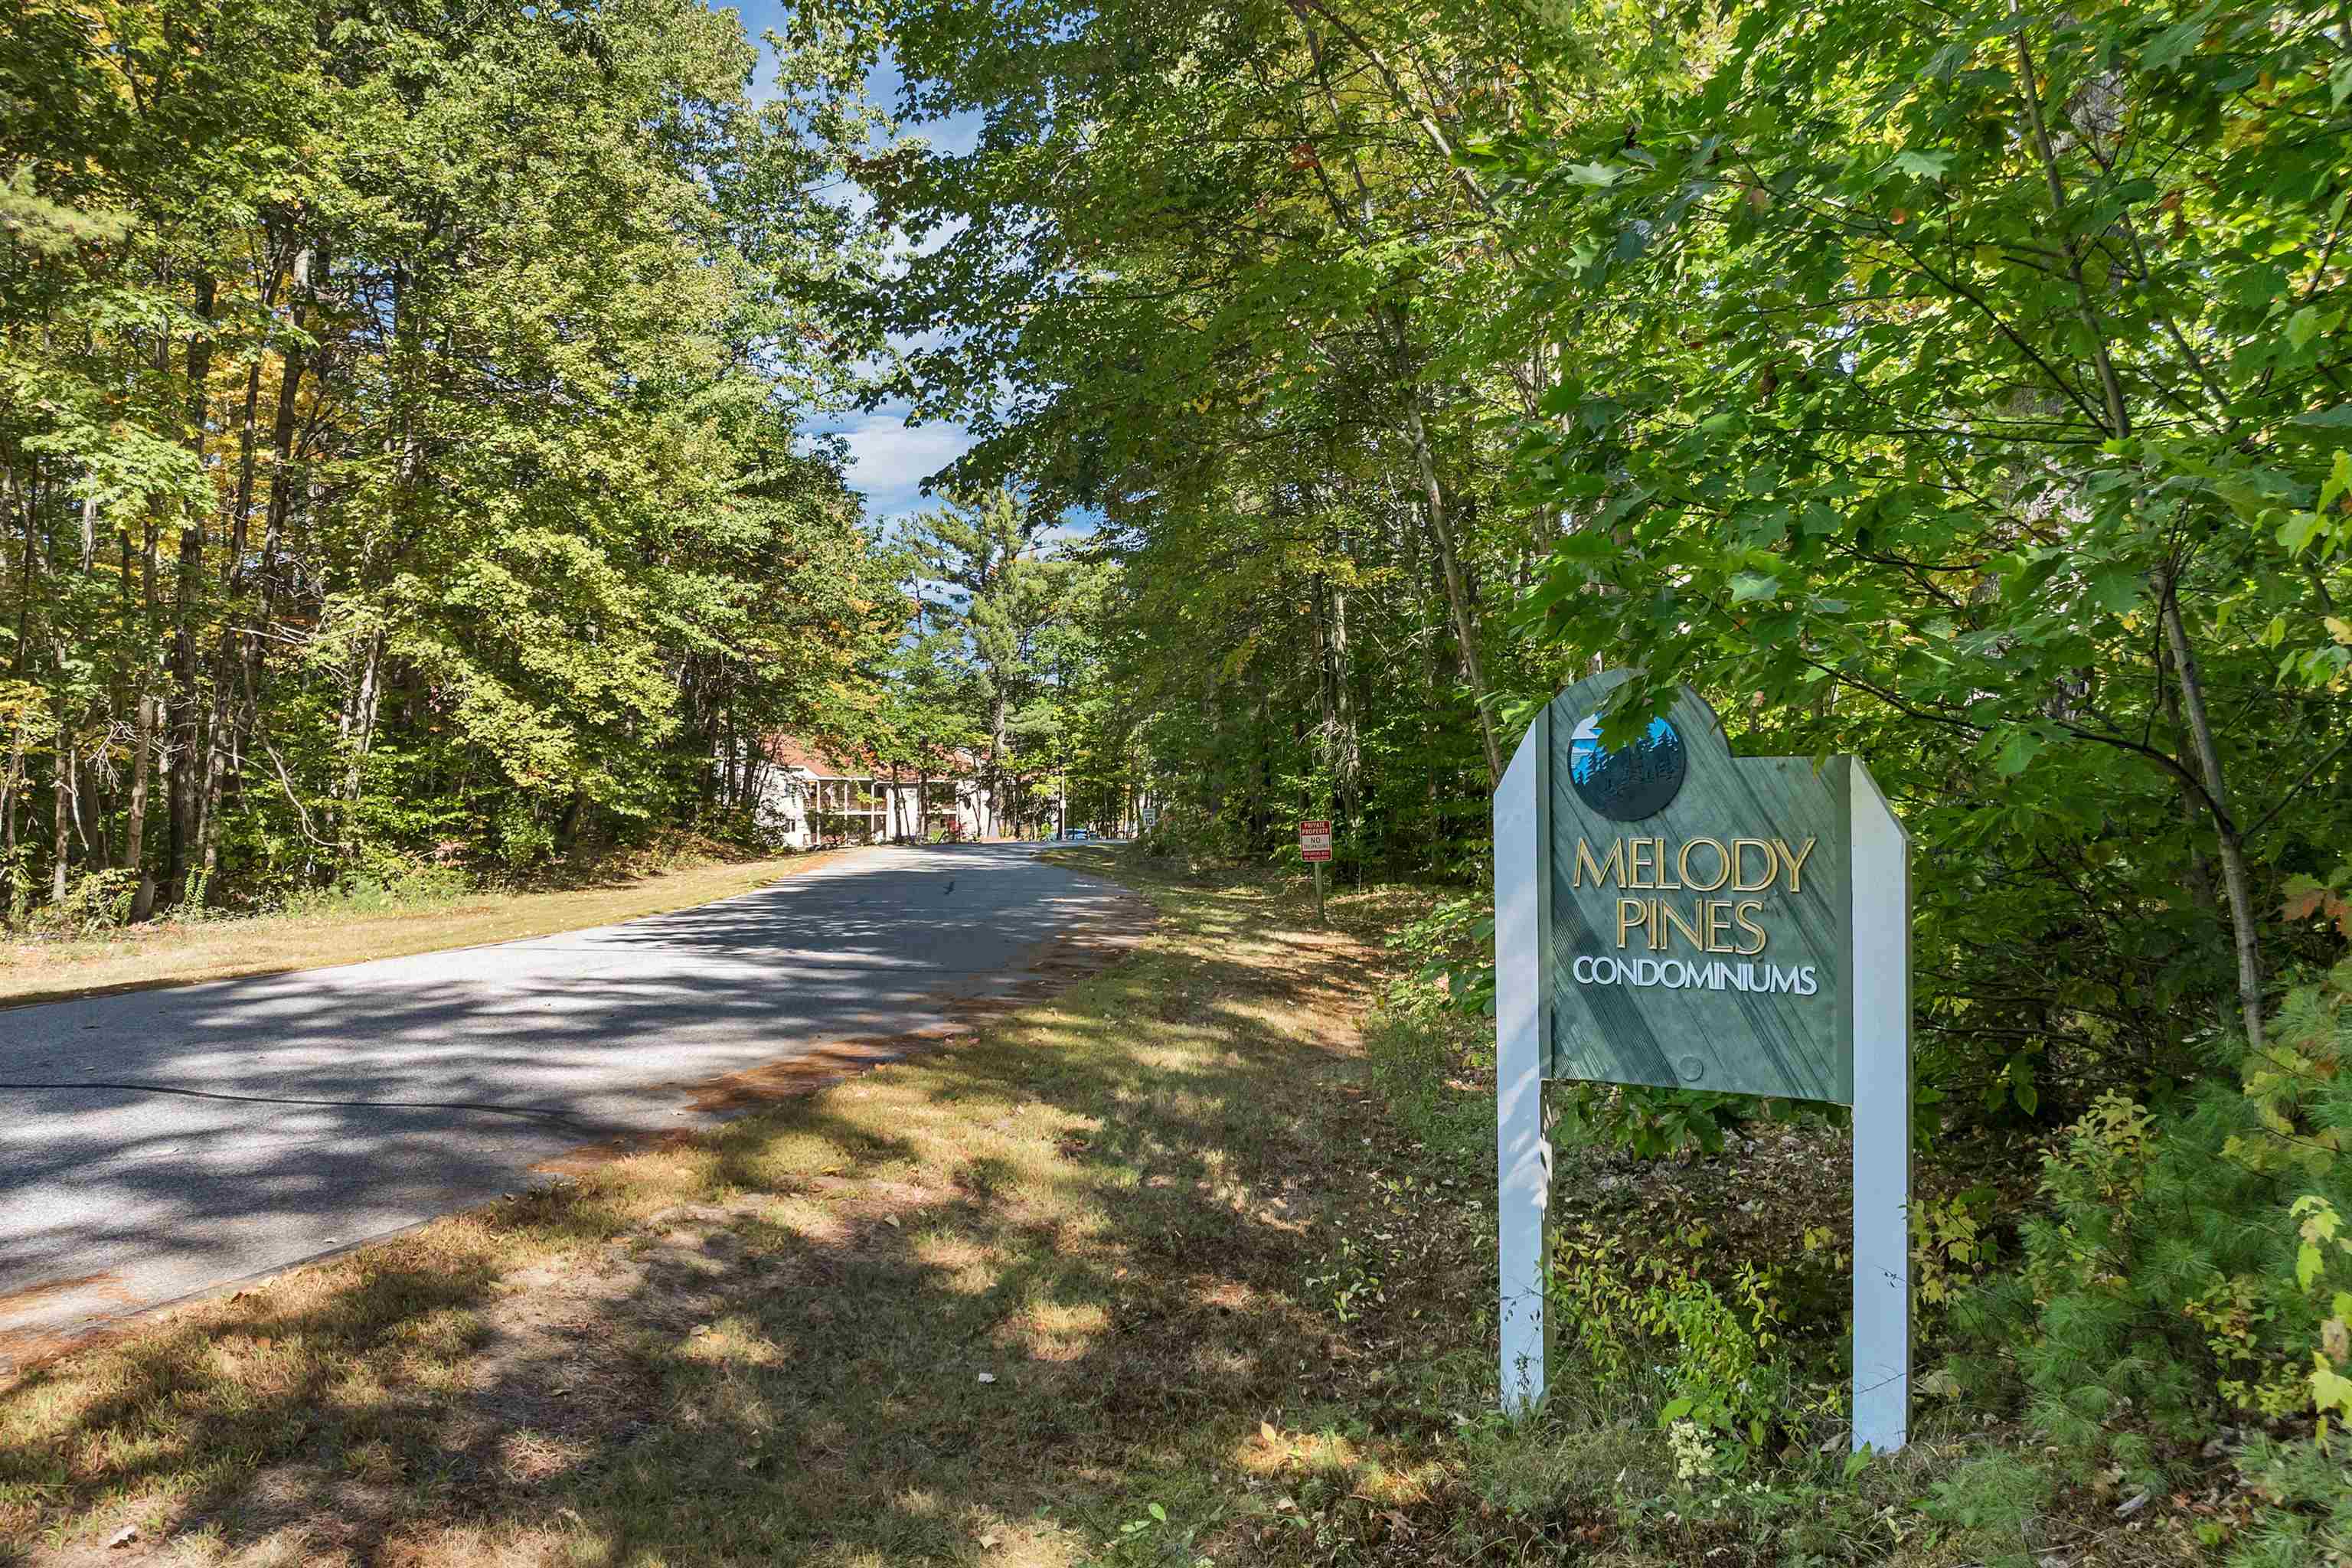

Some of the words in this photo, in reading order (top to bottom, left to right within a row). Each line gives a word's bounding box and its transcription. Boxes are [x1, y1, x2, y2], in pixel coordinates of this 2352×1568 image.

[1573, 837, 1818, 893] MELODY
[1616, 897, 1767, 956] PINES
[1573, 956, 1818, 995] CONDOMINIUMS
